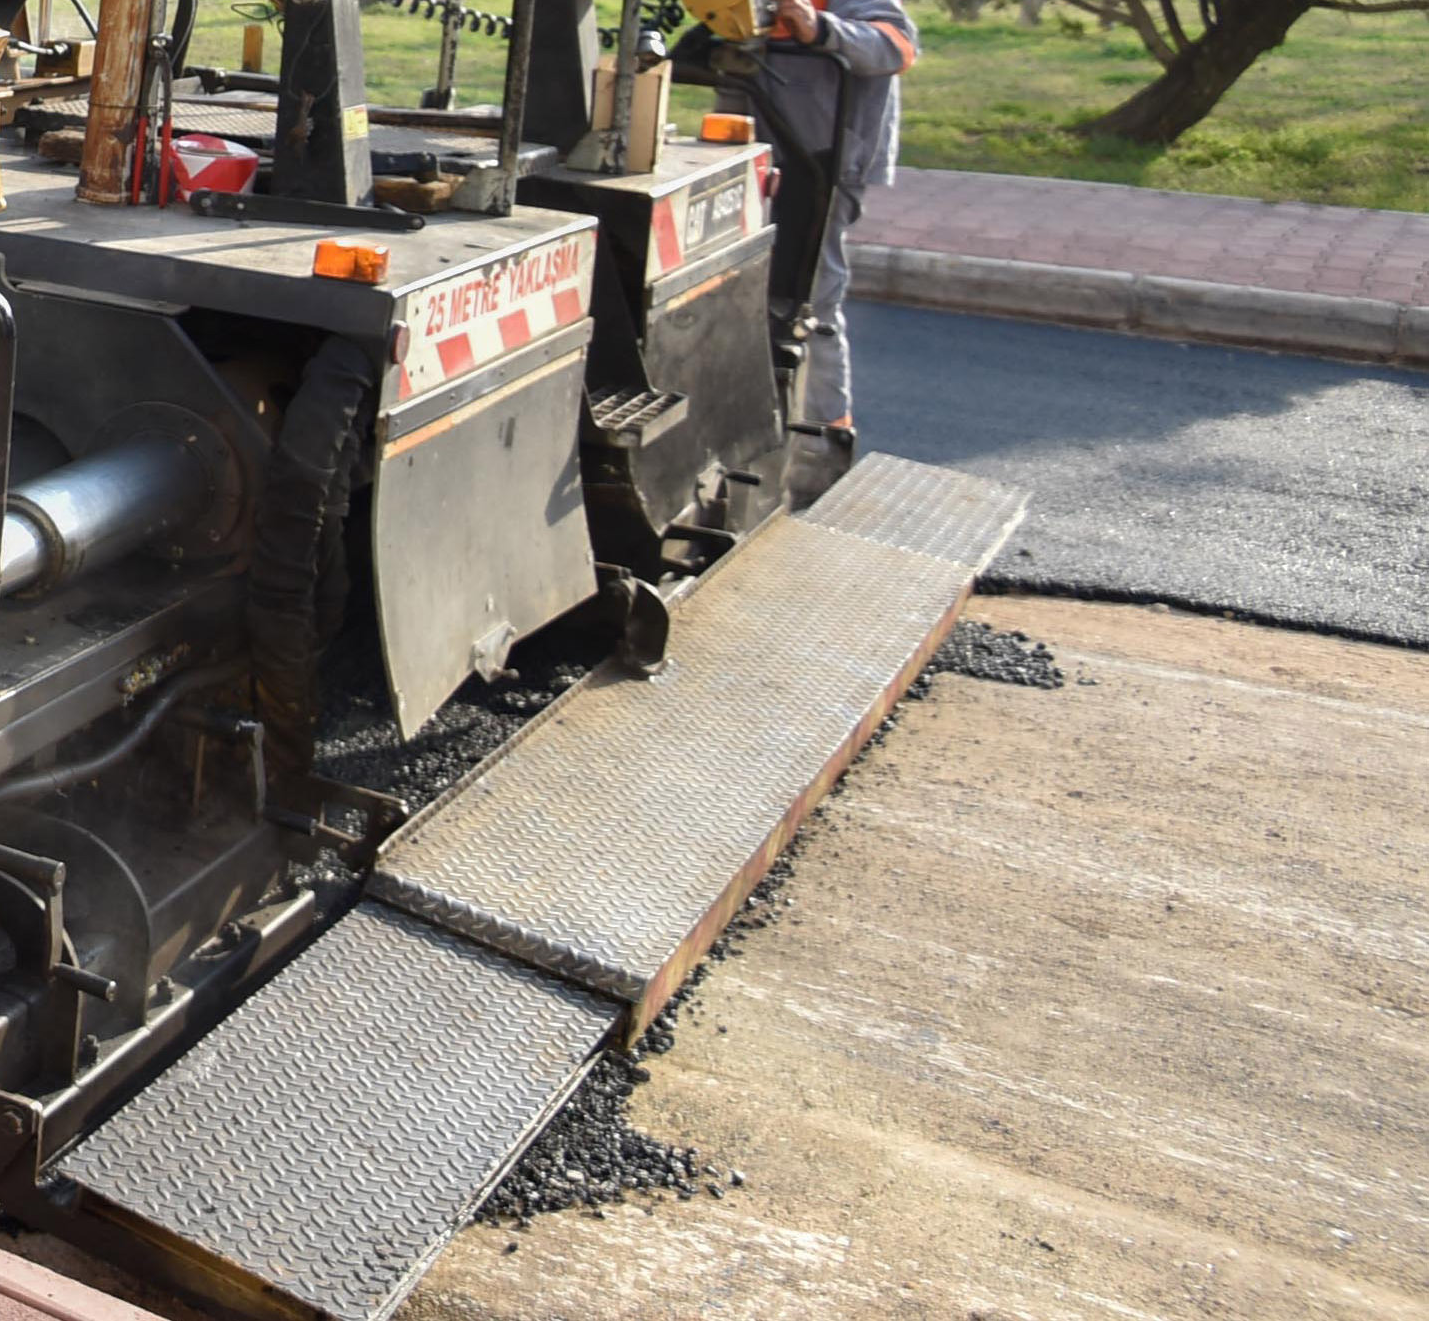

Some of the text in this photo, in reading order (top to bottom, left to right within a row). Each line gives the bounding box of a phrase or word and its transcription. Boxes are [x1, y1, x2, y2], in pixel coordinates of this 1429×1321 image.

[425, 241, 580, 337] 25 METRE YAKLAŞMA
